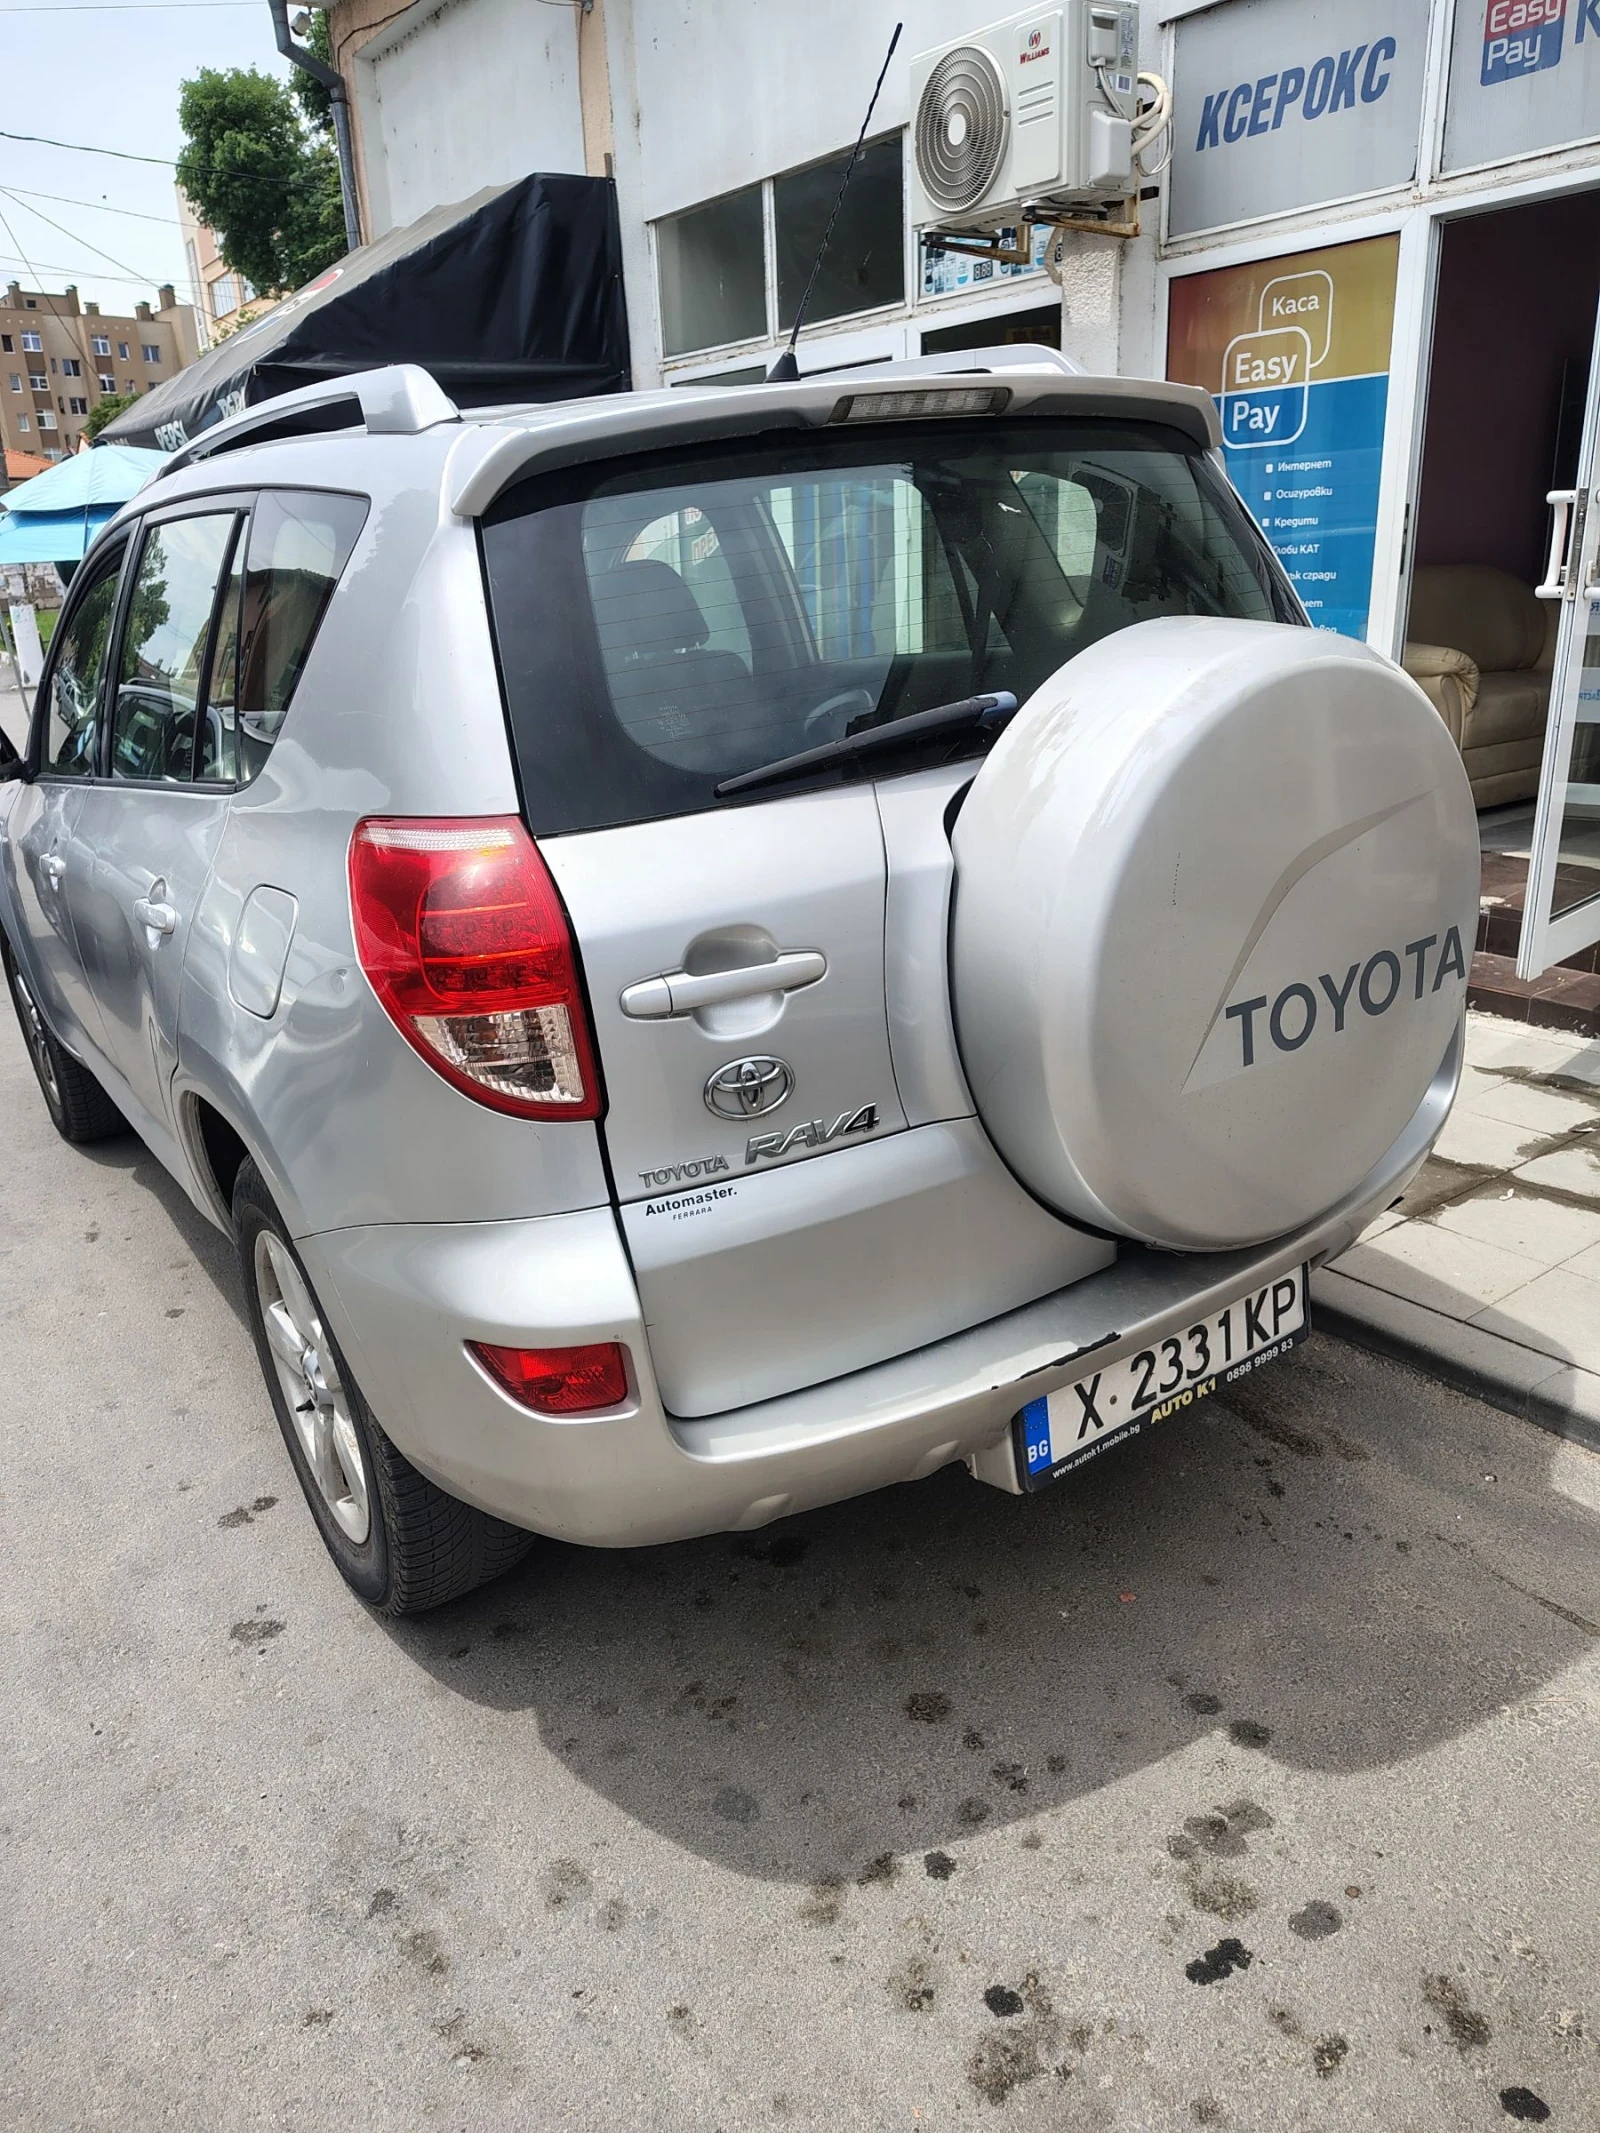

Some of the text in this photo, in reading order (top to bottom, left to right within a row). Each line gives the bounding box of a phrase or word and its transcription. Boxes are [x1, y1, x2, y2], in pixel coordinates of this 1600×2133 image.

[1490, 0, 1561, 33] Easy
[1487, 34, 1542, 70] Pay
[1195, 37, 1397, 152] КСЕРОКС
[1272, 294, 1320, 317] Каса
[1235, 352, 1298, 384] Easy
[1232, 401, 1280, 434] Pay
[1277, 460, 1332, 472] Интернет
[1276, 486, 1333, 500] Осигуровки
[1274, 517, 1319, 528] Кредити
[1302, 571, 1337, 582] сгради
[1225, 925, 1466, 1067] TOYOTA
[638, 1102, 881, 1188] TOYOTA RAV4
[645, 1187, 737, 1216] Automaster.
[672, 1206, 712, 1220] FERRARA
[1226, 1337, 1294, 1383] 0898 9999 83
[1150, 1376, 1217, 1424] AUTO K1
[1027, 1439, 1049, 1464] BG
[1052, 1424, 1140, 1479] www.autok1.mobile.bg
